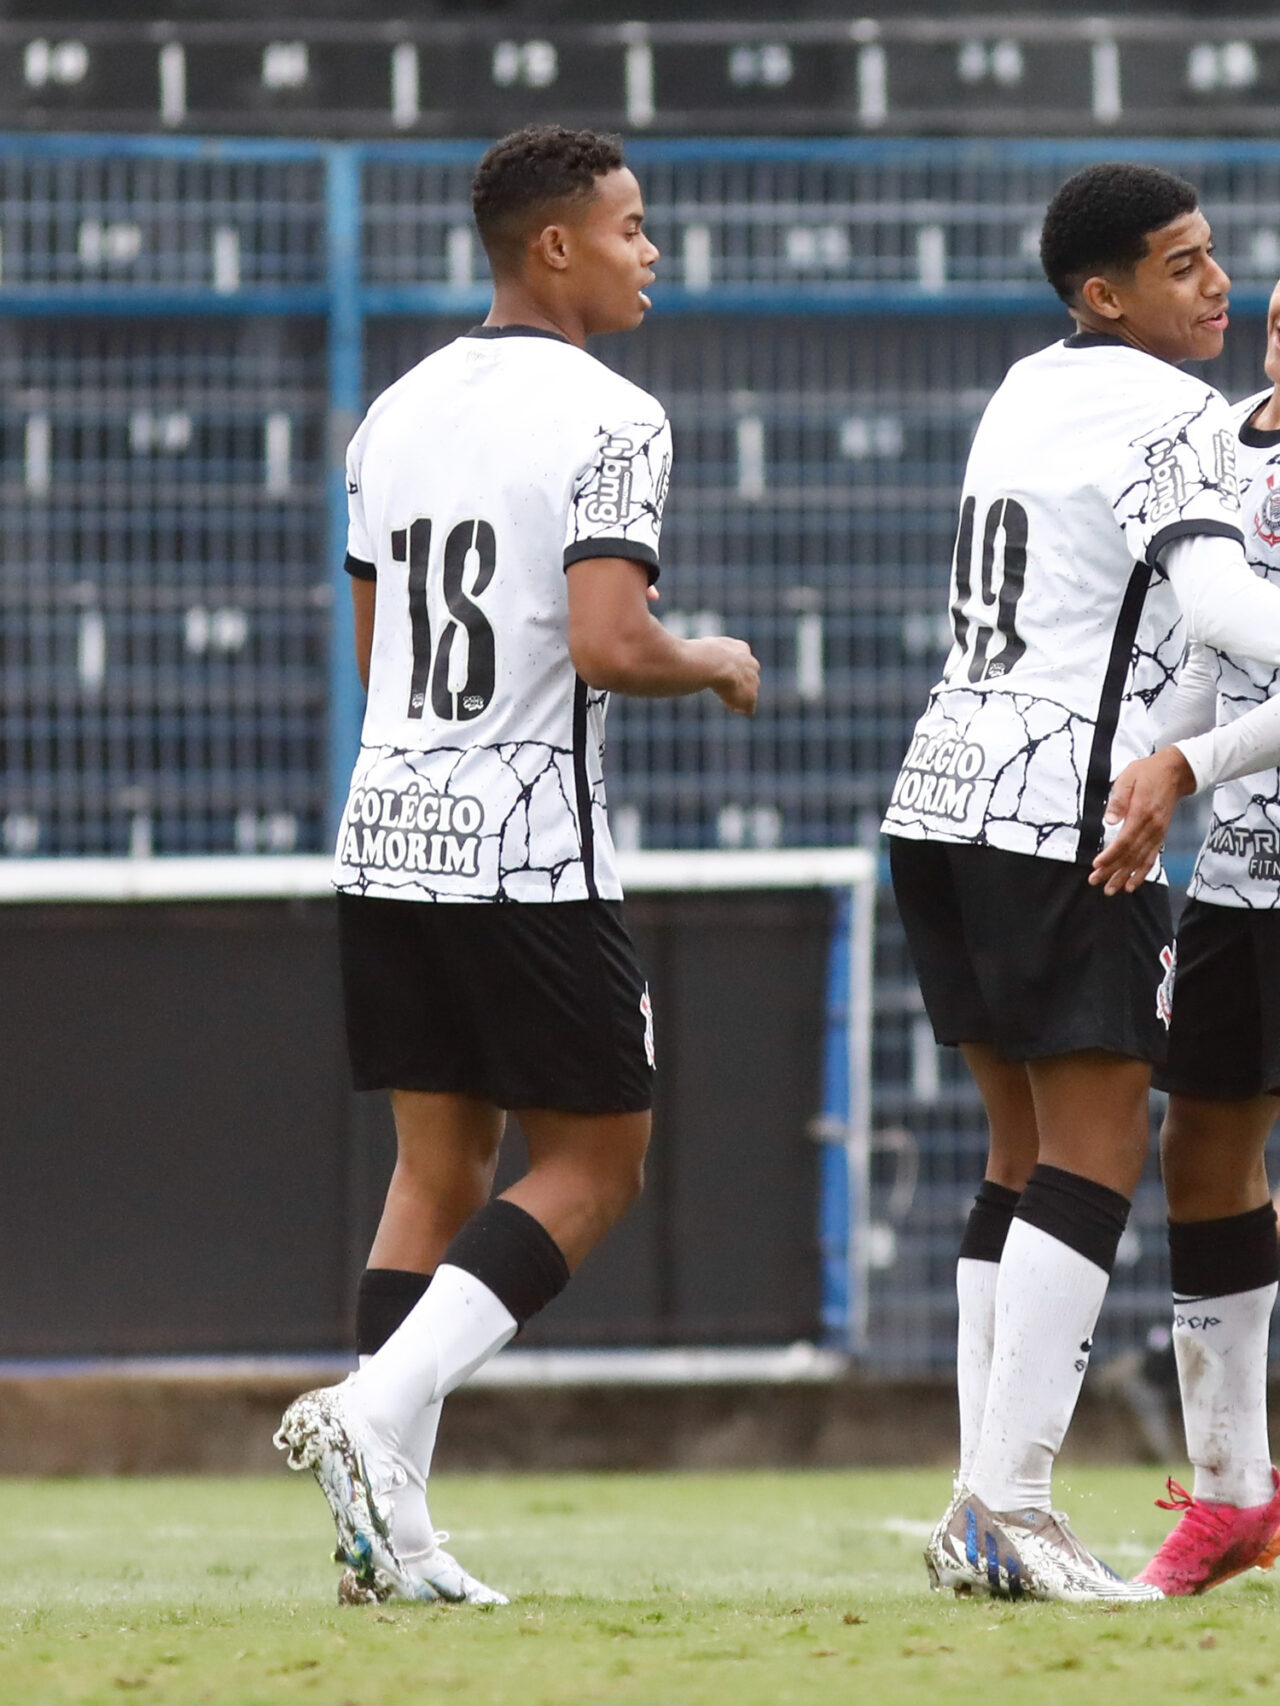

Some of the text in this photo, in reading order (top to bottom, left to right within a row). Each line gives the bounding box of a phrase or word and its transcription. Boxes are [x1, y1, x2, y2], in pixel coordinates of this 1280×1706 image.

[586, 459, 630, 524] bmg
[1151, 457, 1179, 522] bmg
[391, 518, 497, 721] 18
[946, 496, 1028, 684] 19
[347, 783, 483, 834] COLÉGIO
[342, 825, 479, 875] AMORIM
